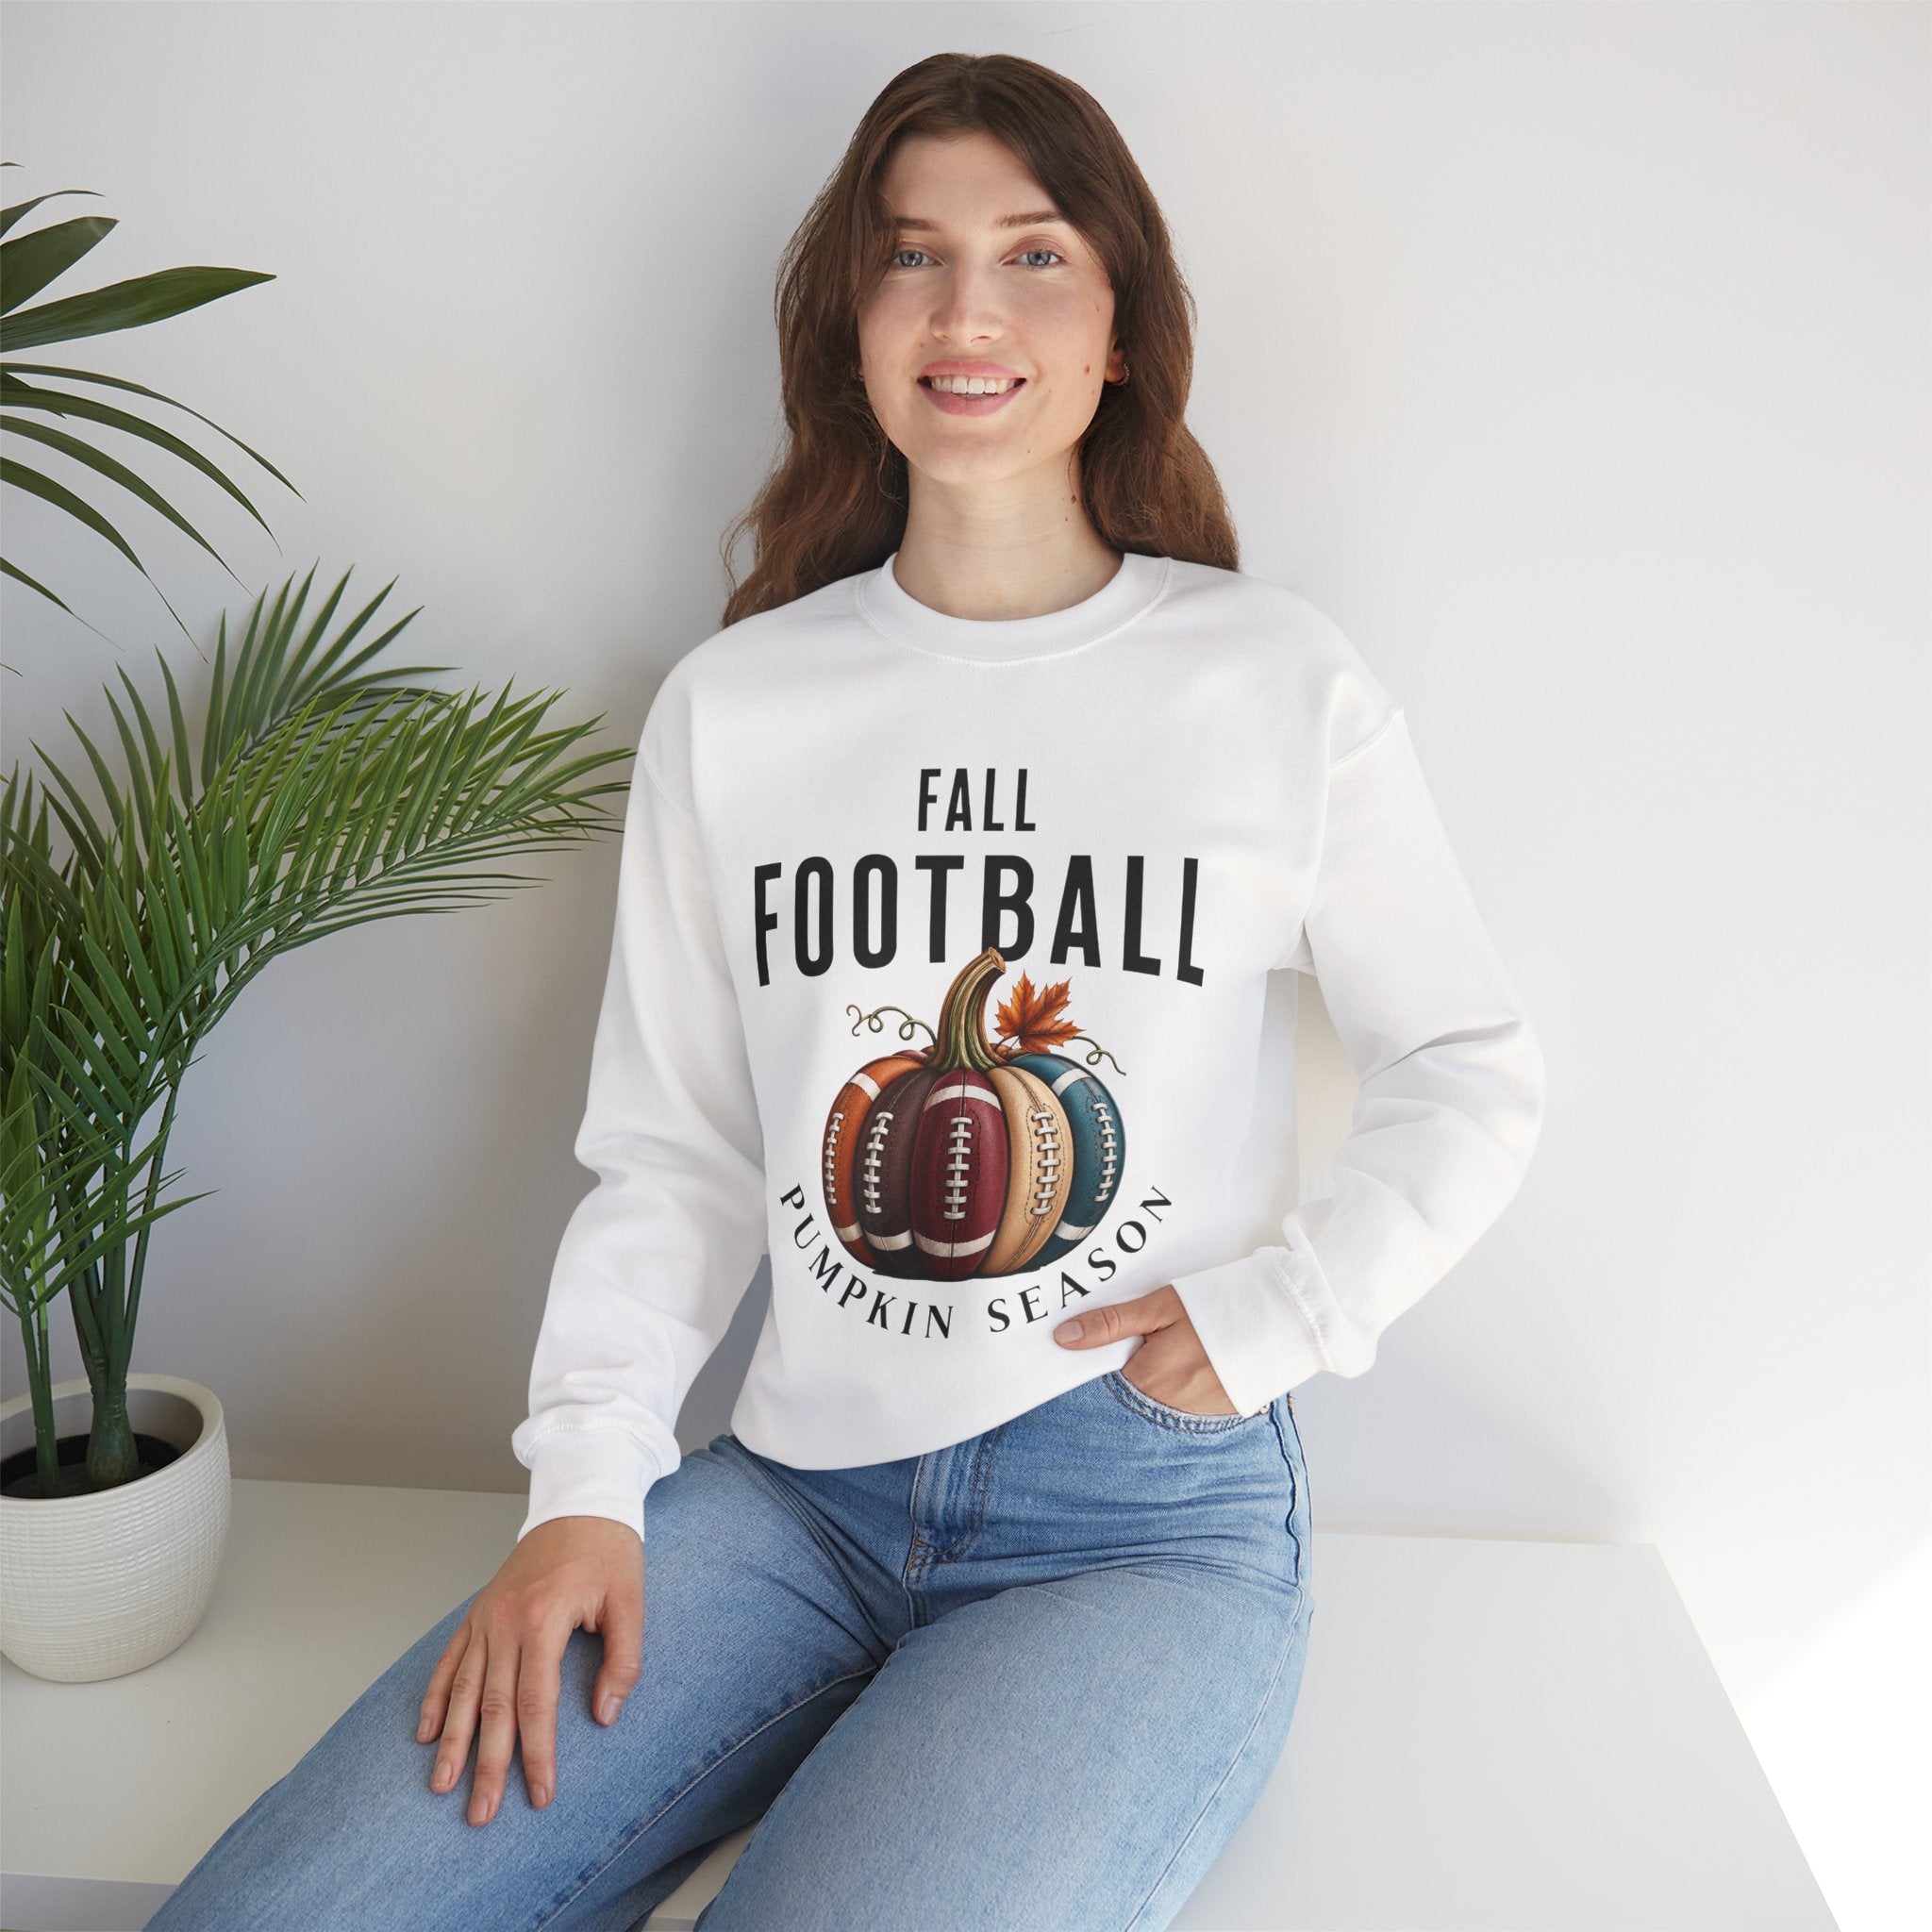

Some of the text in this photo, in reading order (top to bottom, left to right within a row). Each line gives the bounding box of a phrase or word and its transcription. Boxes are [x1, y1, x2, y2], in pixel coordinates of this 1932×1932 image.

[918, 768, 1036, 832] FALL
[754, 854, 1205, 988] FOOTBALL
[779, 1183, 1174, 1340] PUMPKIN SEASON
